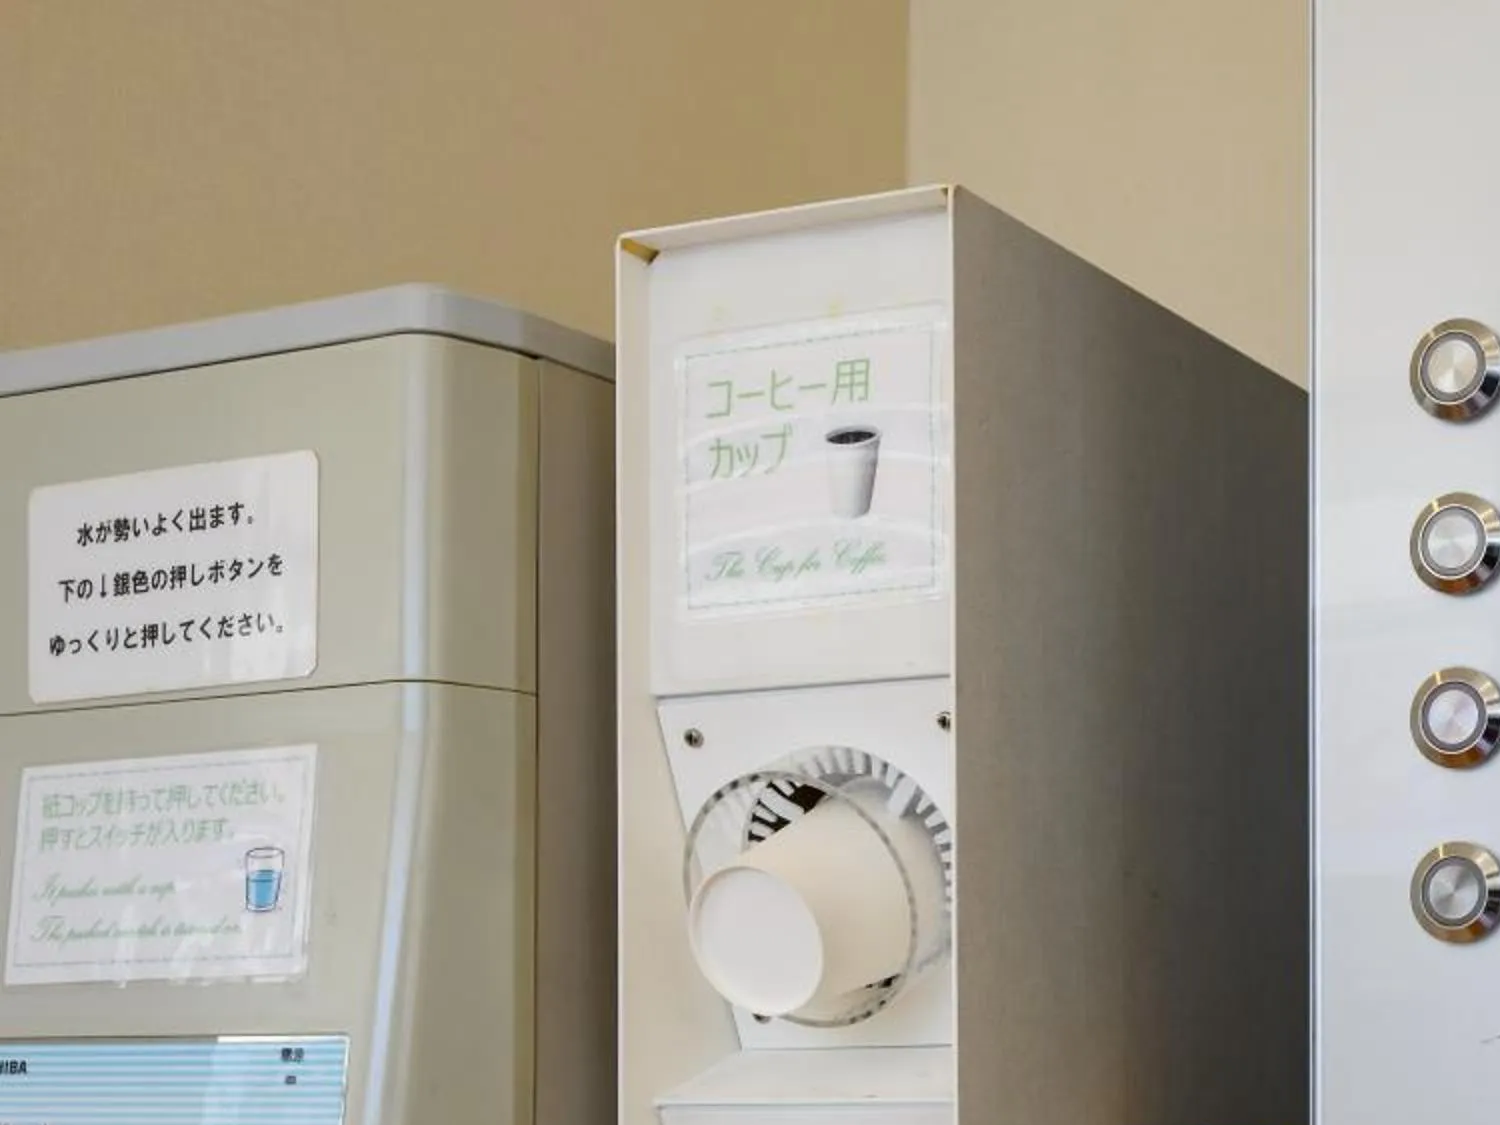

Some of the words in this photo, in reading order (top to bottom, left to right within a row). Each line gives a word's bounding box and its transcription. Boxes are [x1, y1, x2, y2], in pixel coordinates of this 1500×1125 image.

[704, 358, 870, 419] コーヒー用
[708, 423, 793, 480] カップ
[76, 502, 254, 547] 水が勢いよく出ます。
[49, 613, 284, 656] ゆっくりと押してください。
